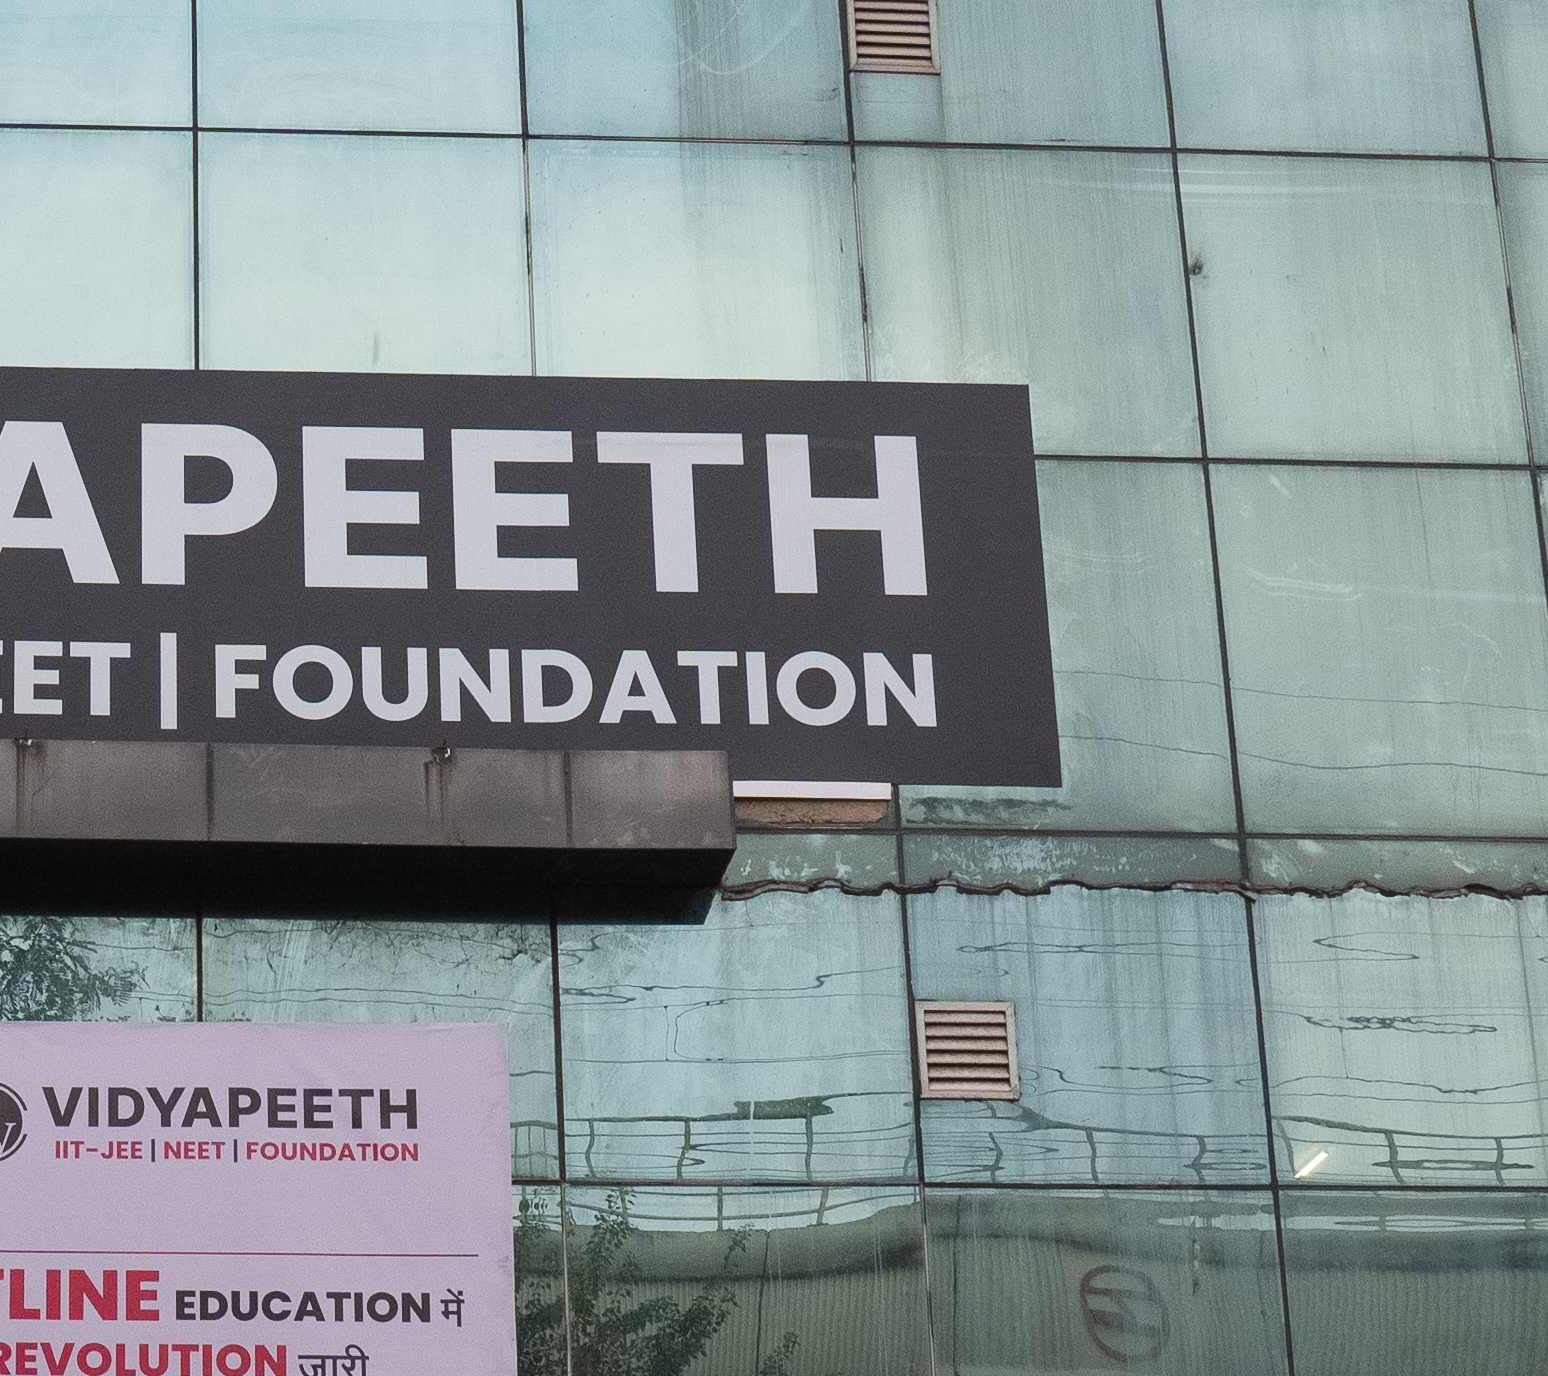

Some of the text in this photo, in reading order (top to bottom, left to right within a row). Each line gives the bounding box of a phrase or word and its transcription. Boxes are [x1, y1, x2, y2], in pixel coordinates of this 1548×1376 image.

[216, 643, 938, 731] FOUNDATION
[42, 1084, 419, 1130] VIDYAPEETH
[54, 1139, 144, 1161] IIT-JEE
[163, 1141, 226, 1162] NEET
[245, 1141, 420, 1164] FOUNDATION
[175, 1291, 430, 1324] EDUCATION
[439, 1288, 465, 1328] में
